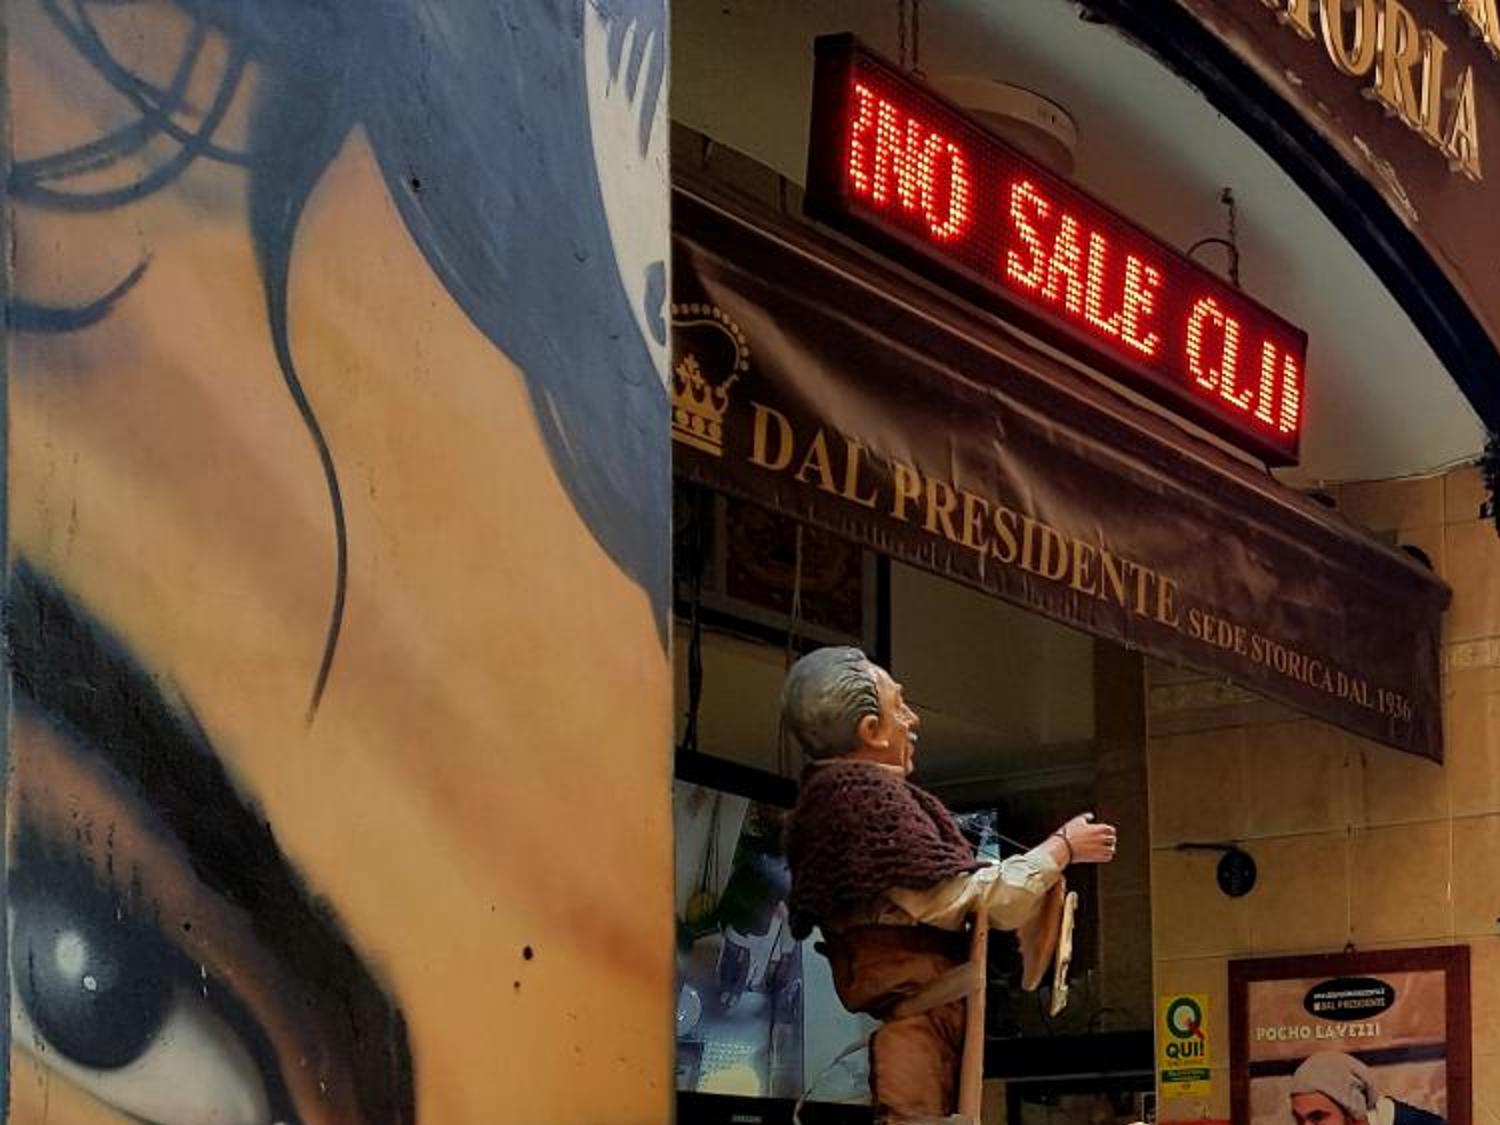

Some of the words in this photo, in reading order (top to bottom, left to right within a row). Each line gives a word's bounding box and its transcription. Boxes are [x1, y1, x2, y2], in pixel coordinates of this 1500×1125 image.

[1007, 179, 1160, 355] SALE
[750, 402, 876, 508] DAL
[890, 460, 1180, 629] PRESIDENTE
[1188, 608, 1247, 656] SEDE
[1250, 633, 1334, 693] STORICA
[1336, 670, 1373, 708] DAL
[1376, 688, 1412, 720] 1936
[1256, 1026, 1311, 1041] POCHO
[1315, 1022, 1380, 1039] LAVEZZI
